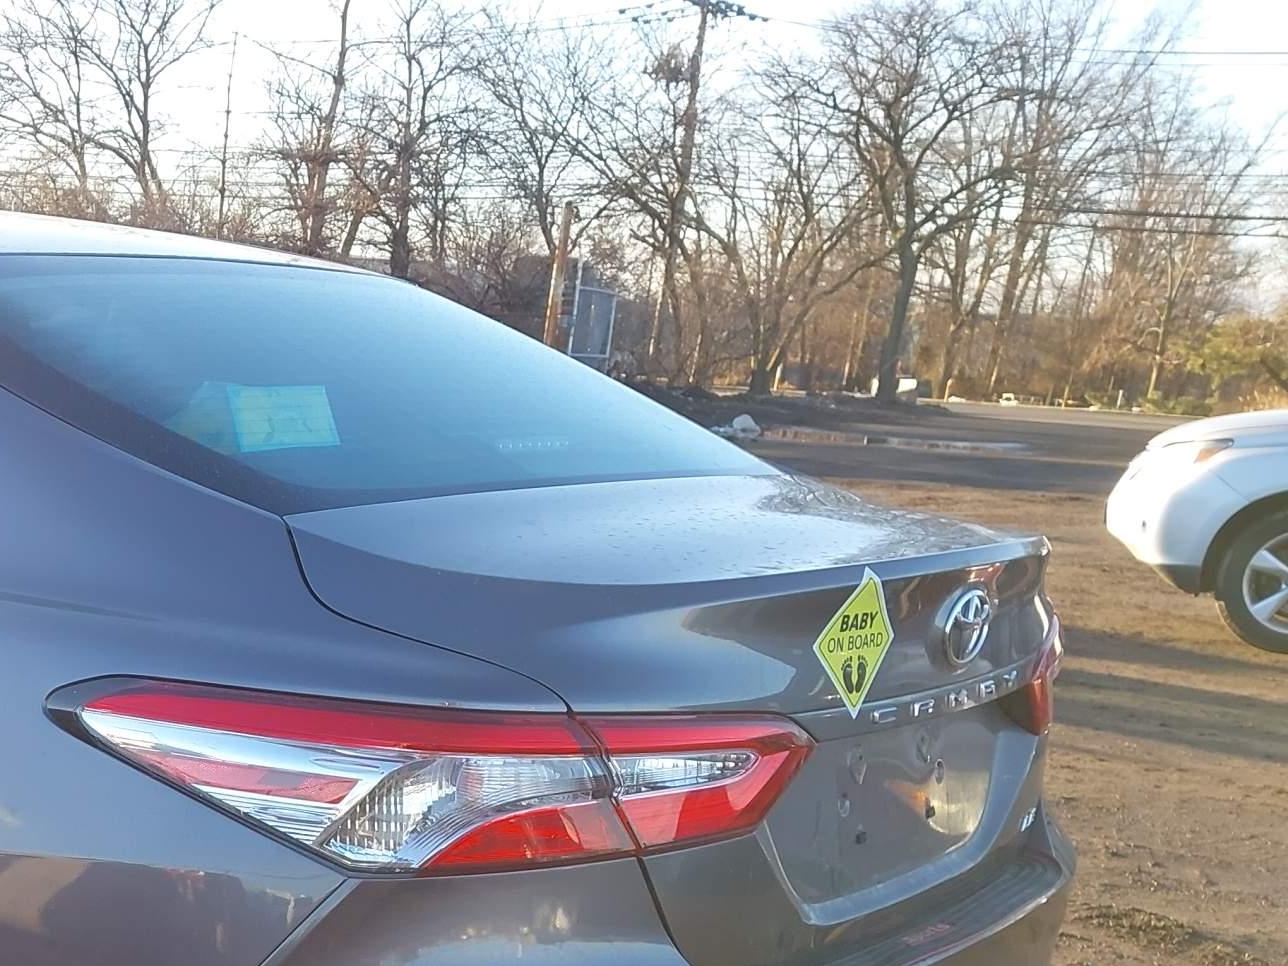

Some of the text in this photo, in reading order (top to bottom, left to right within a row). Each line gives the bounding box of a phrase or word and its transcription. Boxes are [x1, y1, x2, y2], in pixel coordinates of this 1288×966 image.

[840, 611, 878, 632] BABY
[827, 632, 883, 653] ON BOARD
[871, 670, 1017, 724] CAMRY
